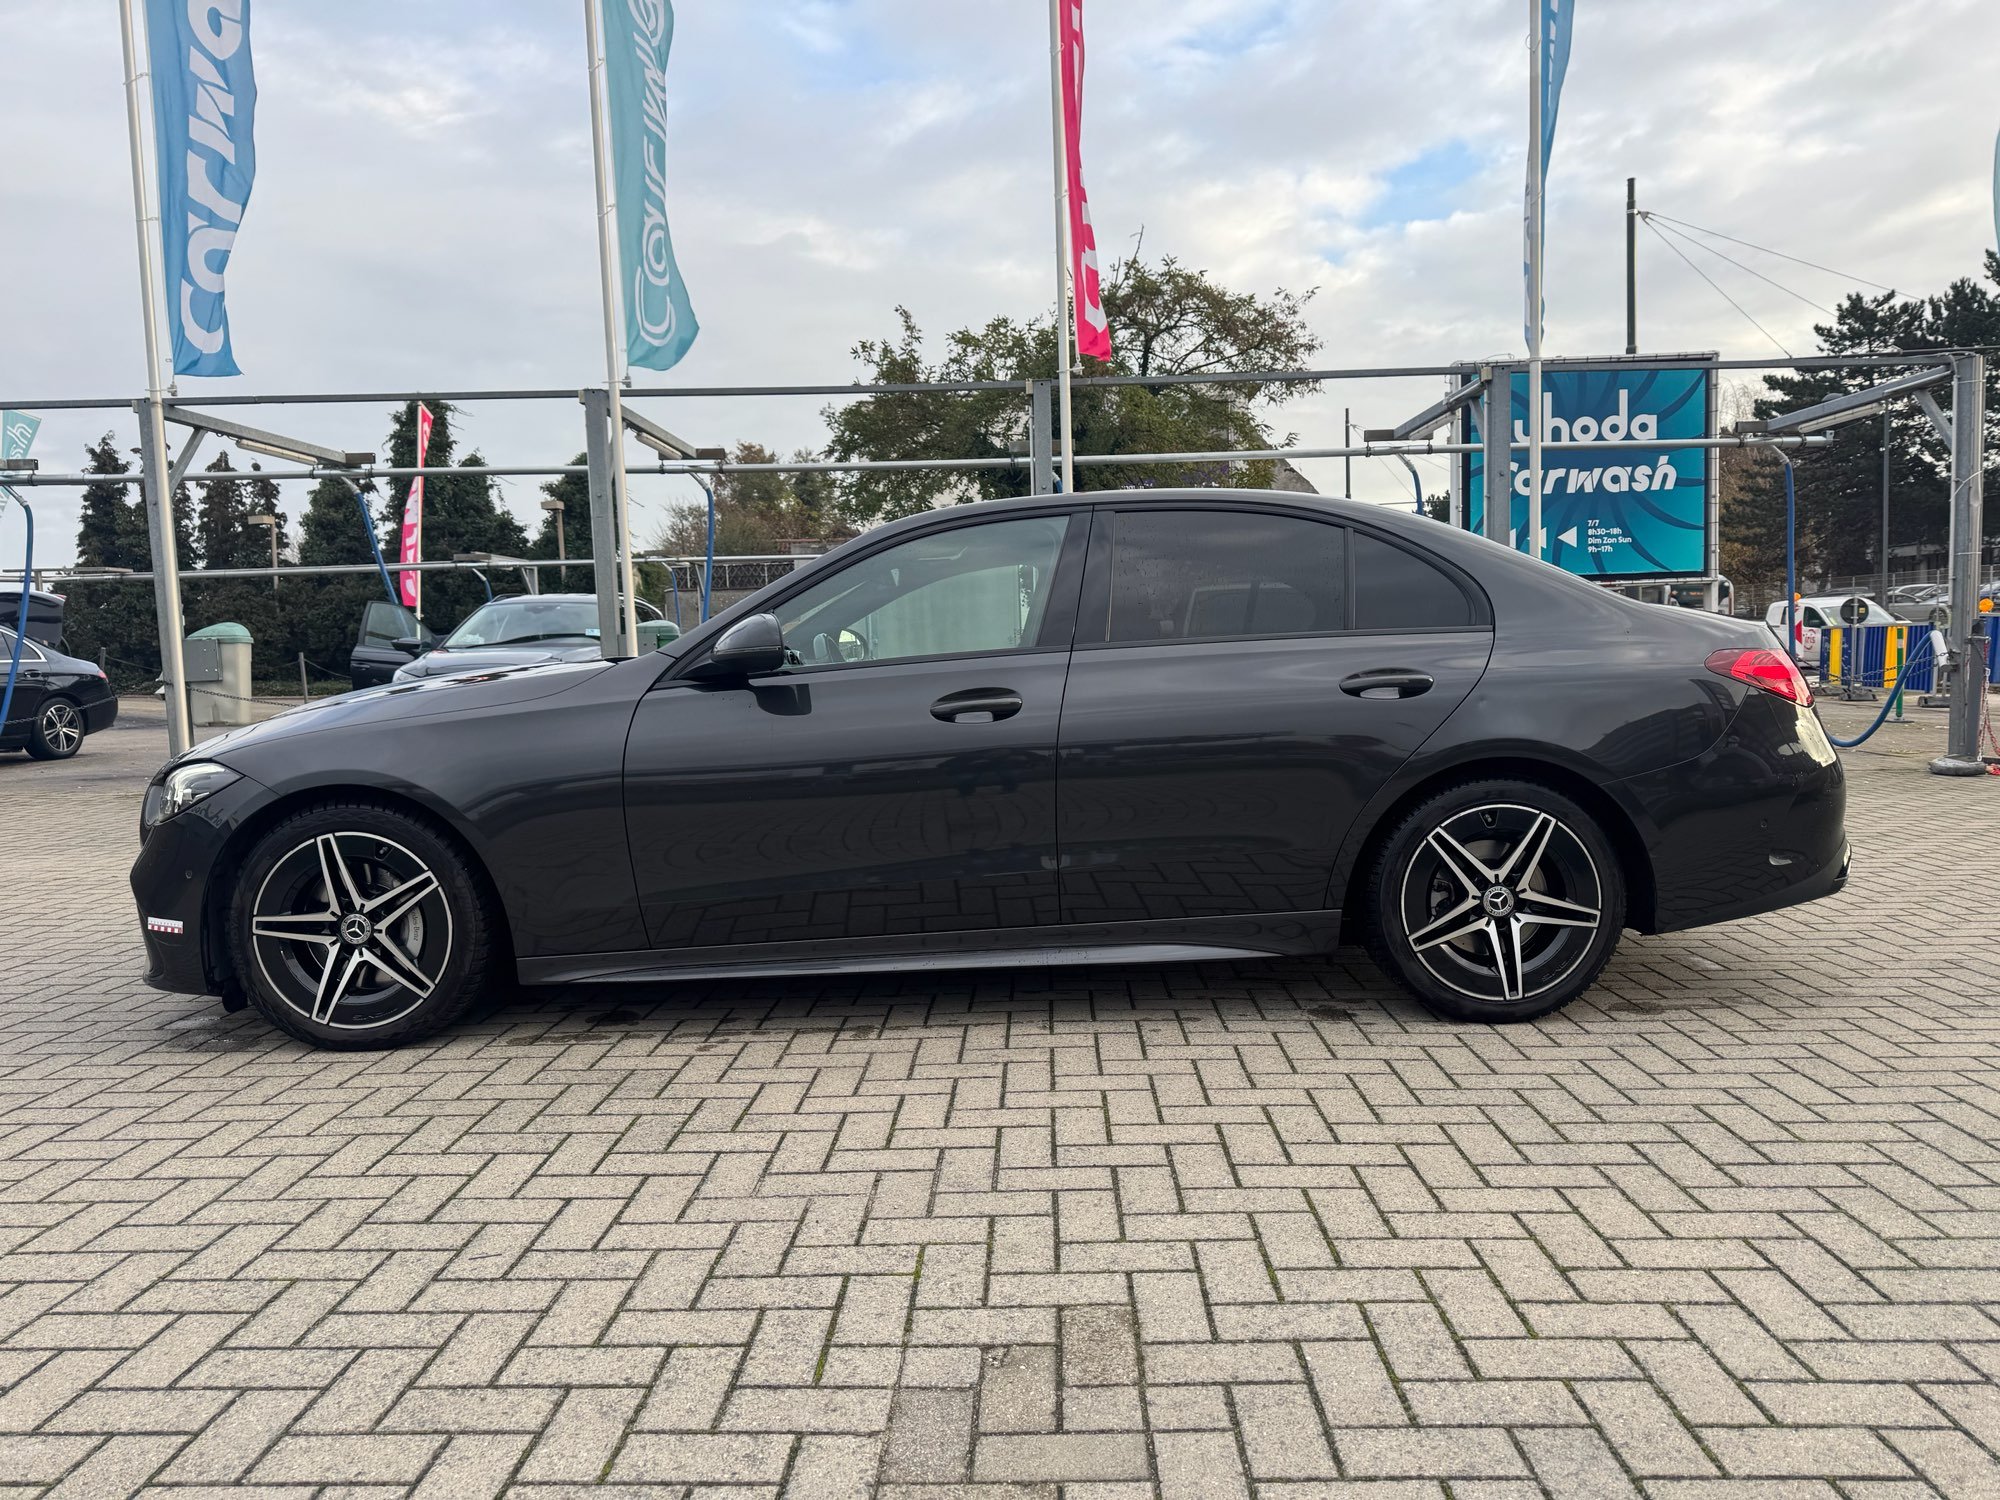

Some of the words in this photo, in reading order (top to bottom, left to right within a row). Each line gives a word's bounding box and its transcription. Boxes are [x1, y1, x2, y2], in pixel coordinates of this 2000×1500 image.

[1587, 519, 1600, 527] 7/7
[1602, 536, 1617, 544] Zon
[1587, 545, 1613, 553] 9h-17h
